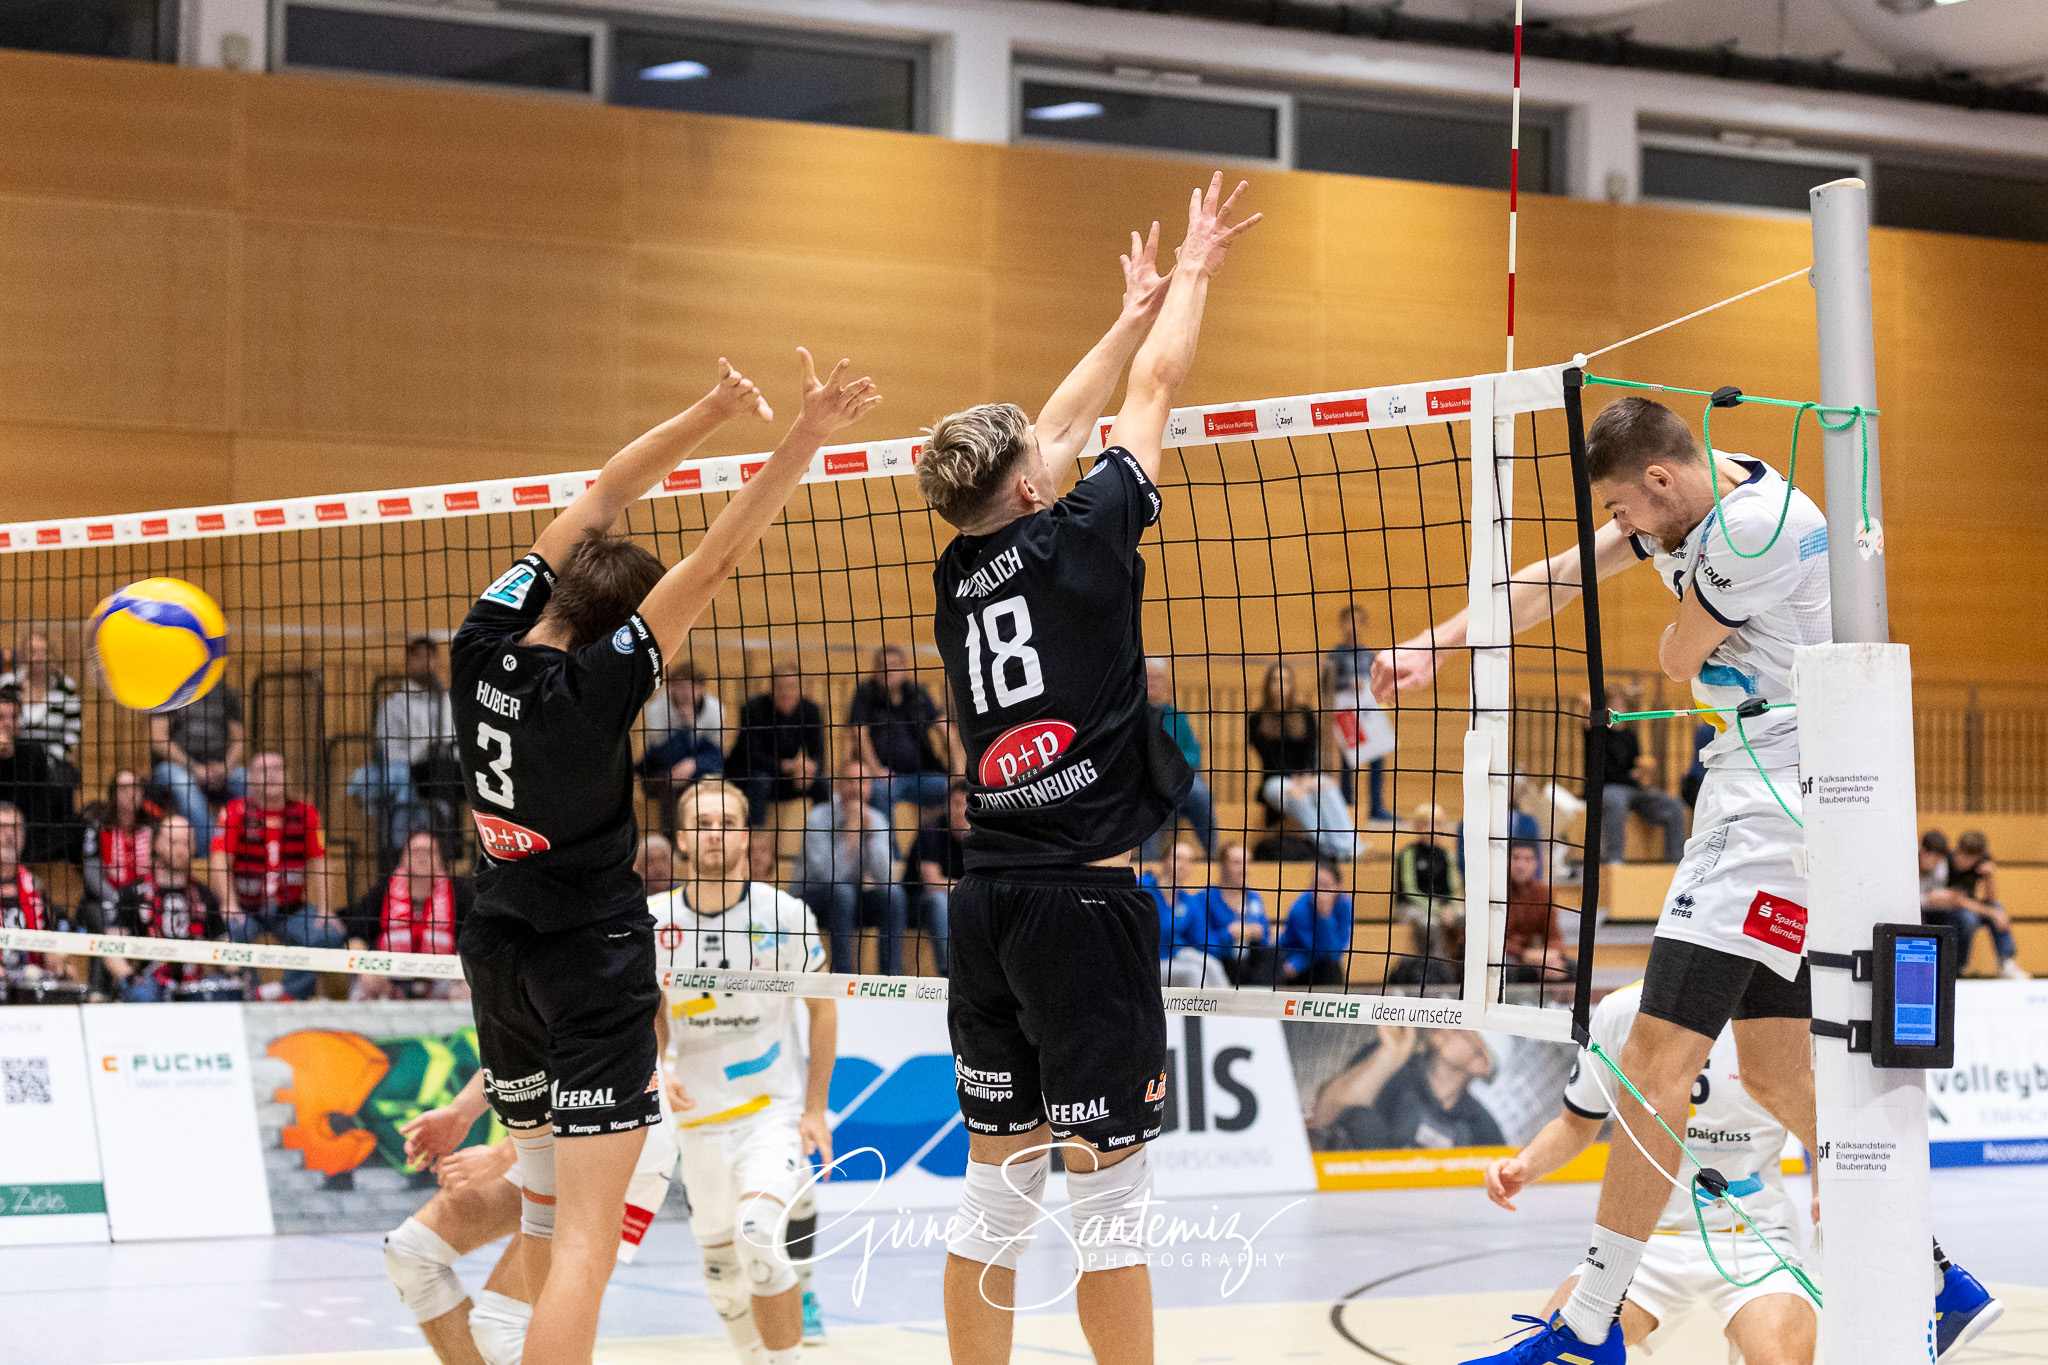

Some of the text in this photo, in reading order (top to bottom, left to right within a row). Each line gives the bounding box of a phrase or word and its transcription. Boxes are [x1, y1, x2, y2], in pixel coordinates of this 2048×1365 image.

[1393, 405, 1407, 414] Zapf
[1280, 416, 1293, 425] Zapf
[1174, 426, 1187, 436] Zapf
[1123, 456, 1146, 485] Kempa
[965, 595, 1045, 715] 18
[475, 680, 521, 720] HUBER
[475, 721, 514, 810] 3
[996, 731, 1060, 787] p+p
[1801, 774, 1879, 798] pf Kalksandsteine
[1819, 785, 1874, 794] Energiewände
[1819, 795, 1870, 804] Bauberatung
[1670, 907, 1692, 919] errea
[674, 973, 795, 993] FUCHS Ideen umsetzen
[860, 982, 908, 998] FUCHS
[915, 983, 942, 1000] Ideen
[1163, 995, 1218, 1013] umsetzen
[1301, 1000, 1463, 1025] FUCHS Ideen umsetze
[132, 1053, 234, 1073] FUCHS
[1051, 1096, 1110, 1122] FERAL
[507, 1118, 537, 1128] Kempa
[569, 1124, 601, 1134] Kempa
[611, 1119, 639, 1130] Kempa
[968, 1117, 998, 1133] Kempa
[1009, 1118, 1038, 1132] Kempa
[1108, 1133, 1136, 1147] Kempa
[1687, 1127, 1751, 1144] Daigfuss
[1836, 1141, 1897, 1149] Kalksandsteine
[1836, 1151, 1891, 1161] Energiewände
[1836, 1162, 1887, 1171] Bauberatung
